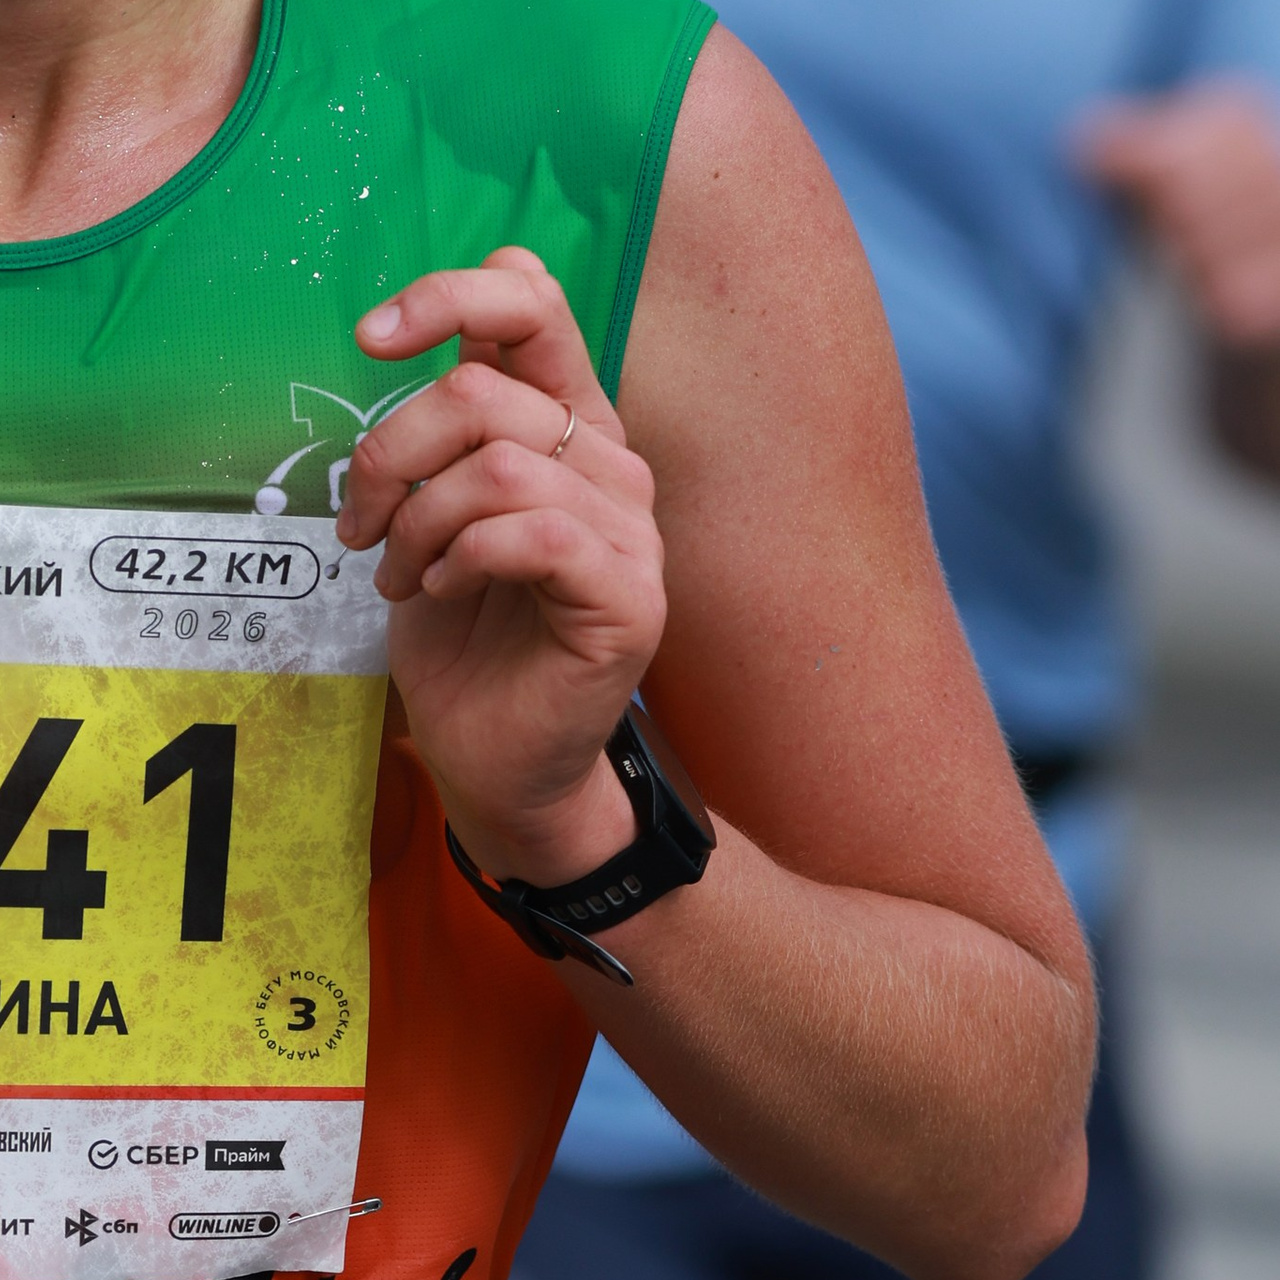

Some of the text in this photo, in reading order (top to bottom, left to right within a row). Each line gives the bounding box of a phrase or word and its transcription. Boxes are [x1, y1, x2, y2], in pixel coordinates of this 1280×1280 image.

[115, 548, 208, 586] 42,2
[139, 607, 267, 642] 2026
[622, 759, 636, 778] RUN
[254, 970, 350, 1061] БЕГУ МОСКОВСКИЙ МАРАФОН
[287, 997, 317, 1032] 3
[126, 1145, 271, 1165] СБЕР Прайм
[177, 1218, 257, 1234] WINLINE
